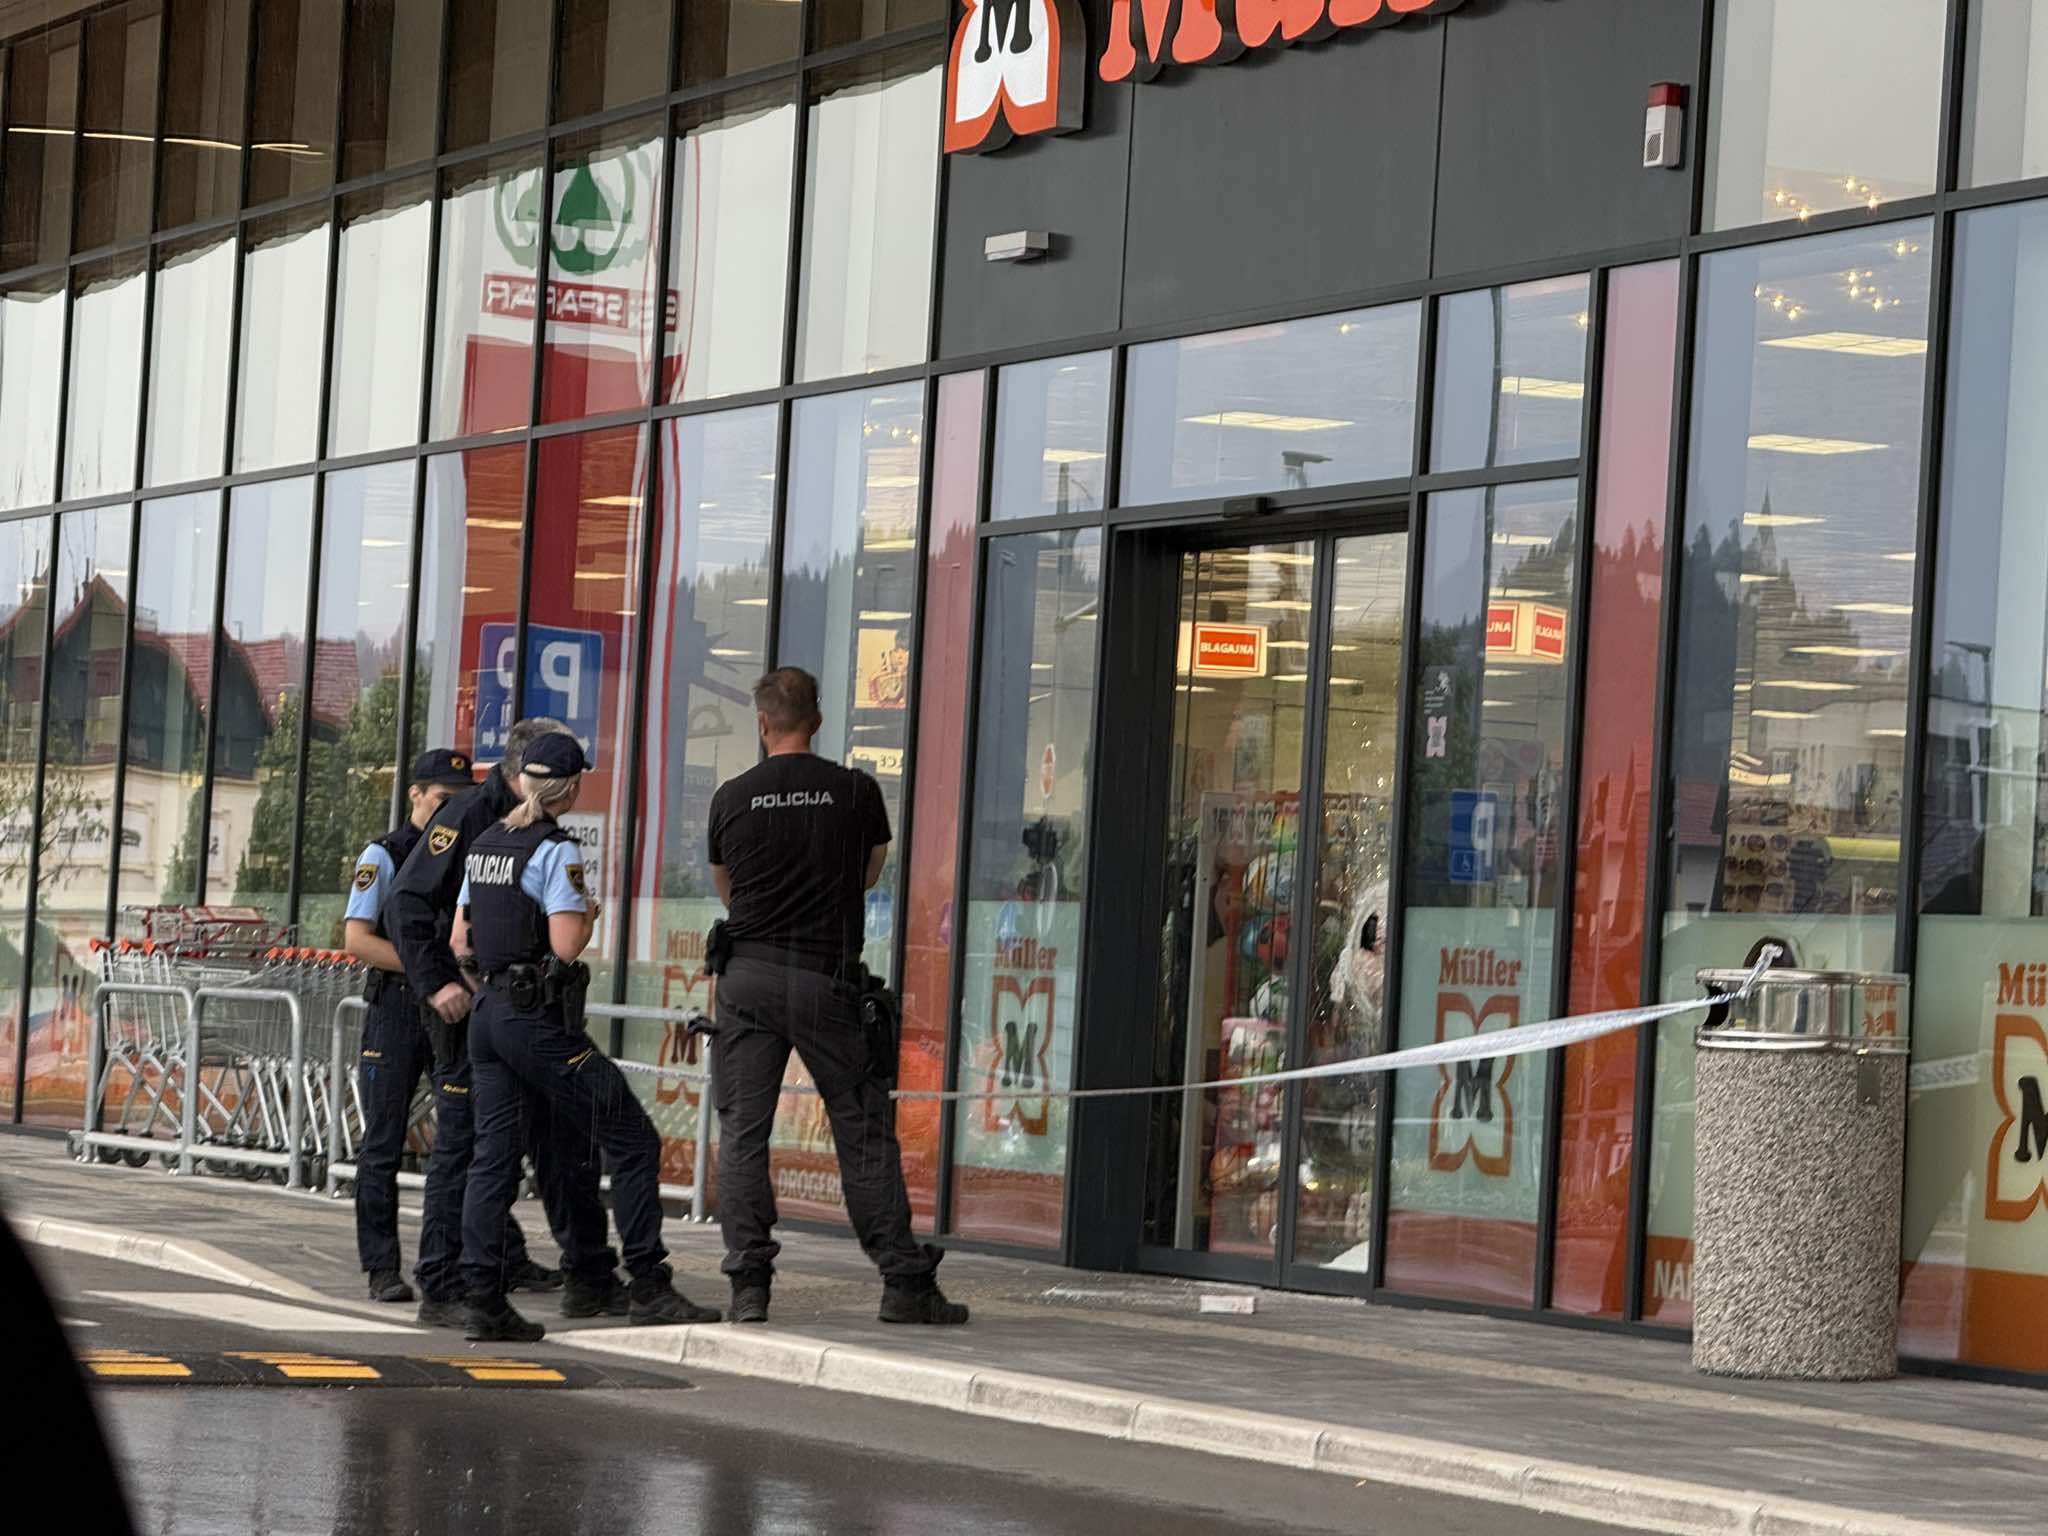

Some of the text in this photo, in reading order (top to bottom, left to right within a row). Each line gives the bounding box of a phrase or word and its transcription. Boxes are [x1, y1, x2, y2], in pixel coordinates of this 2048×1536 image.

[1200, 641, 1254, 655] BLAGAJNA
[751, 791, 834, 811] POLICIJA
[466, 854, 515, 886] POLICIJA
[1438, 947, 1523, 987] Müller
